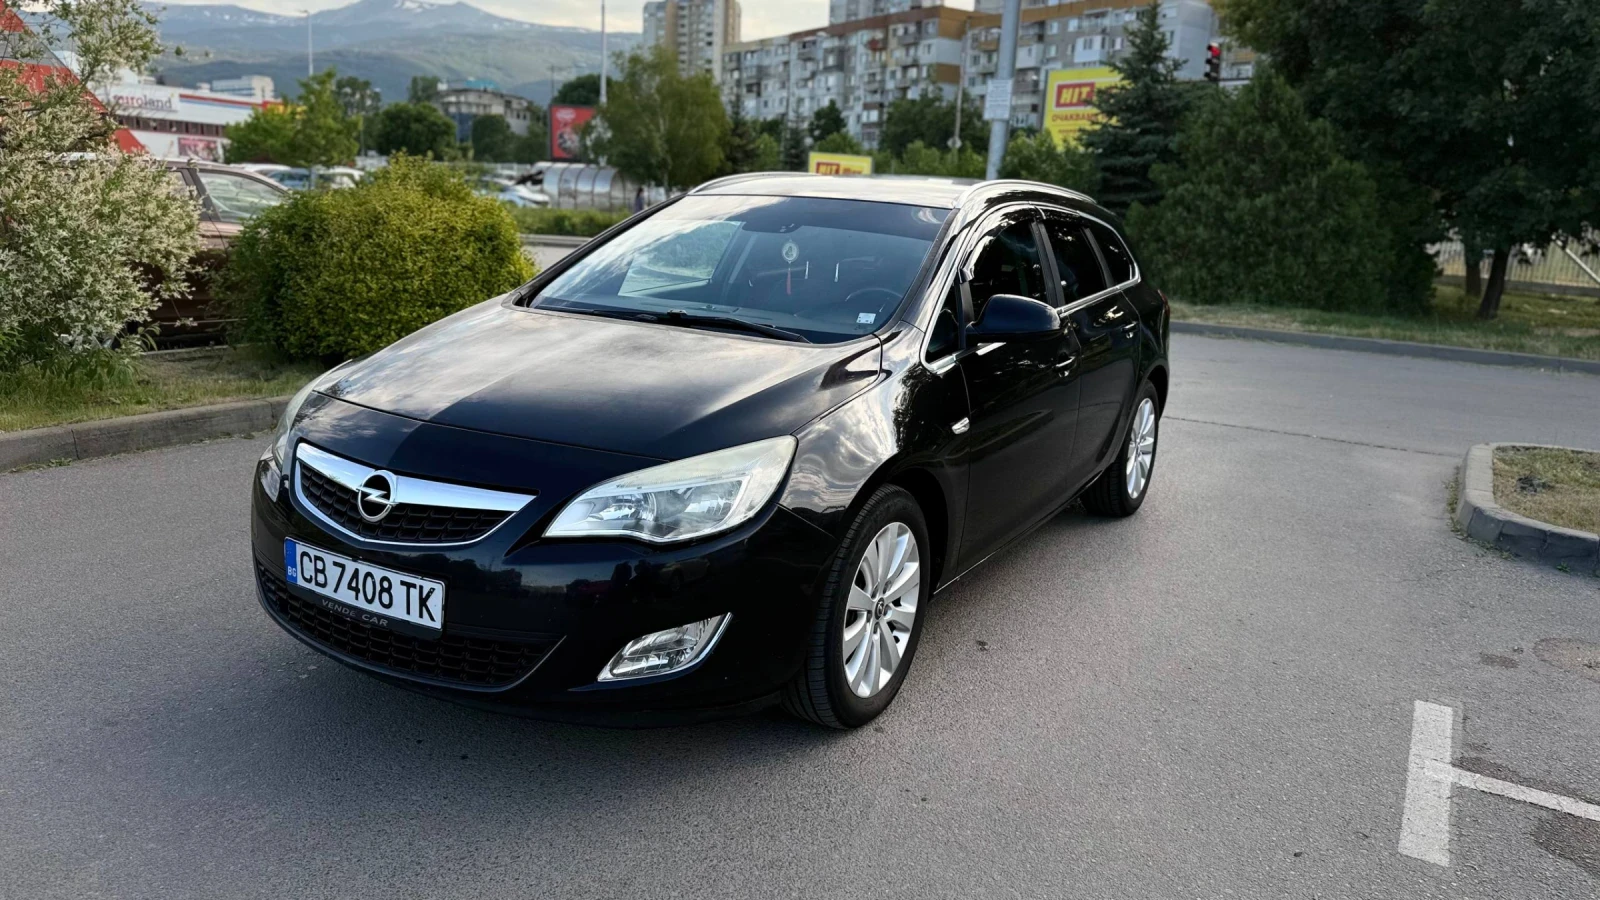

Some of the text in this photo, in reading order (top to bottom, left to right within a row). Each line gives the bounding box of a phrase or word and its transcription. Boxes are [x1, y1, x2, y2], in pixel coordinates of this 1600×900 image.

[1060, 86, 1091, 104] HIT
[287, 565, 297, 577] BG
[300, 551, 436, 622] CB 7408 TK
[321, 599, 389, 627] VENDE CAR
